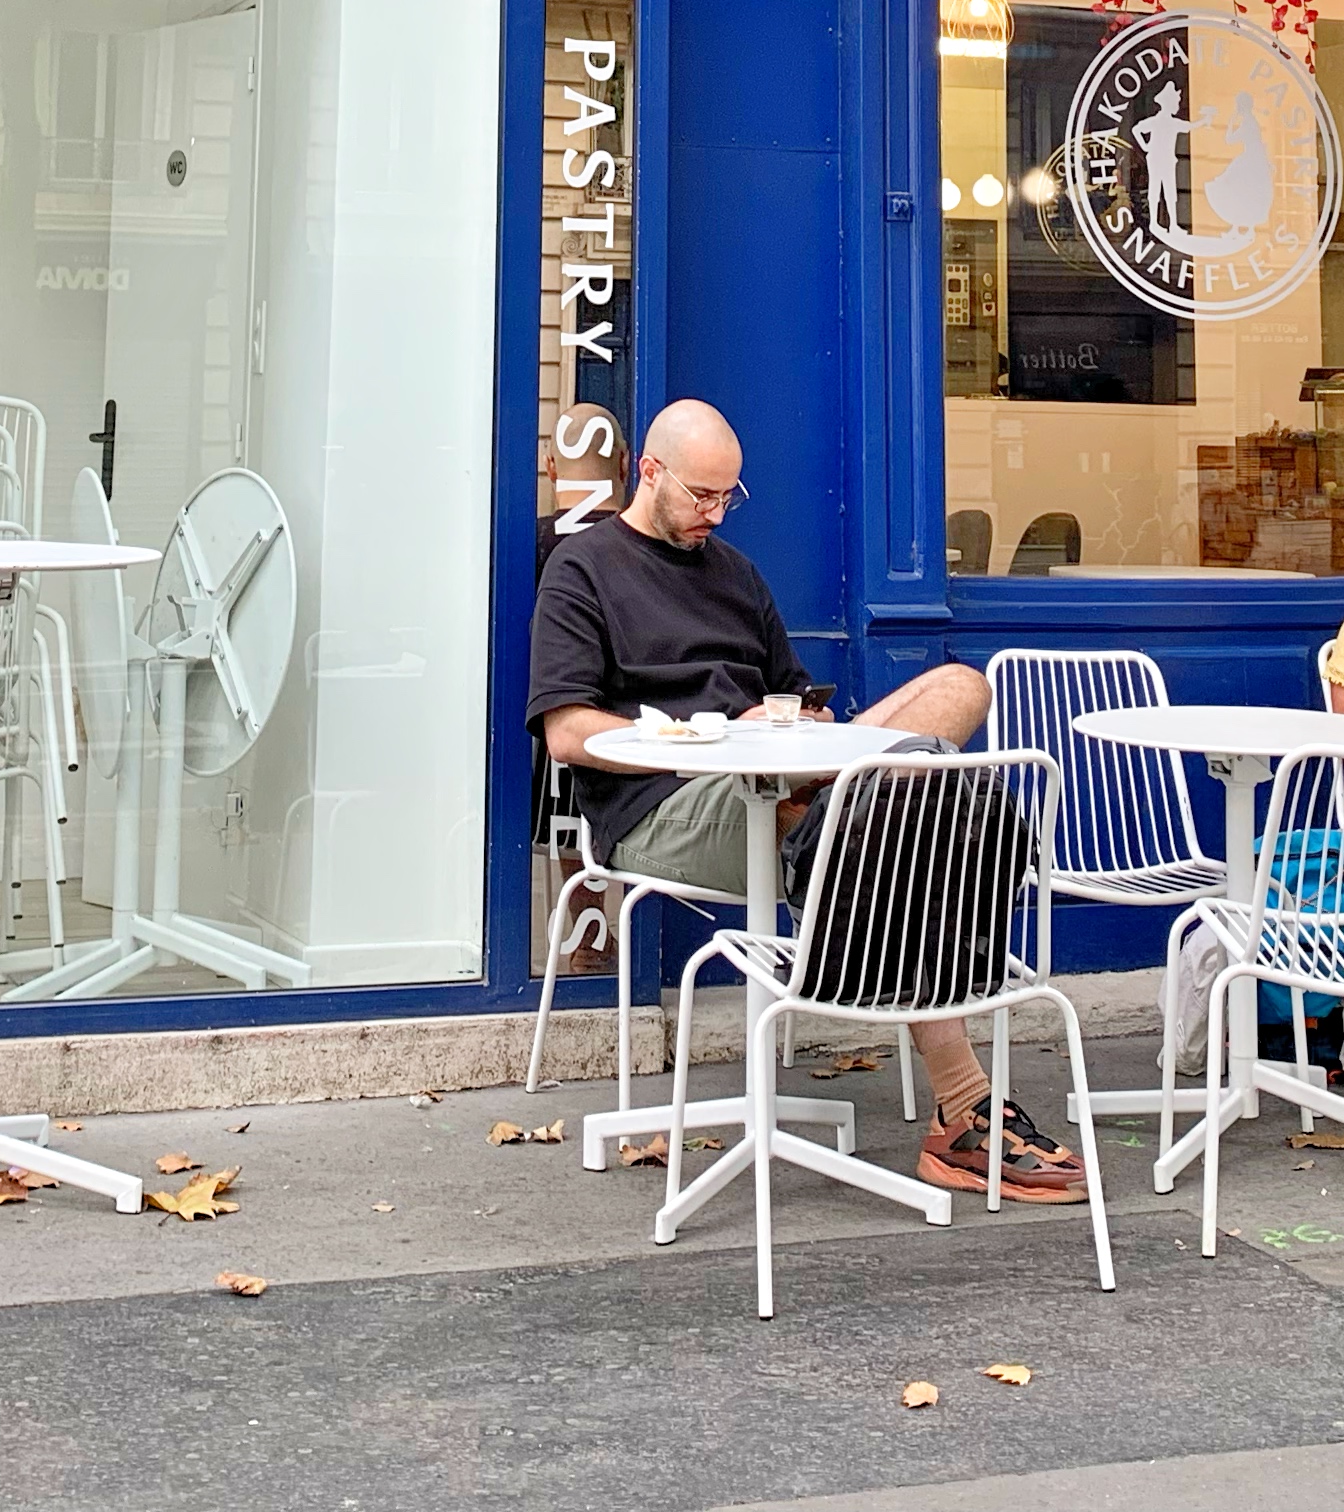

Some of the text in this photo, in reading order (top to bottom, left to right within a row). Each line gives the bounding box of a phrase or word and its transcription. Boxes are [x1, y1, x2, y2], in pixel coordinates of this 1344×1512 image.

[170, 160, 183, 175] WC
[1090, 35, 1230, 186] HAKODATE
[559, 38, 617, 364] PASTRY
[1105, 206, 1300, 293] SNAFFLE'S
